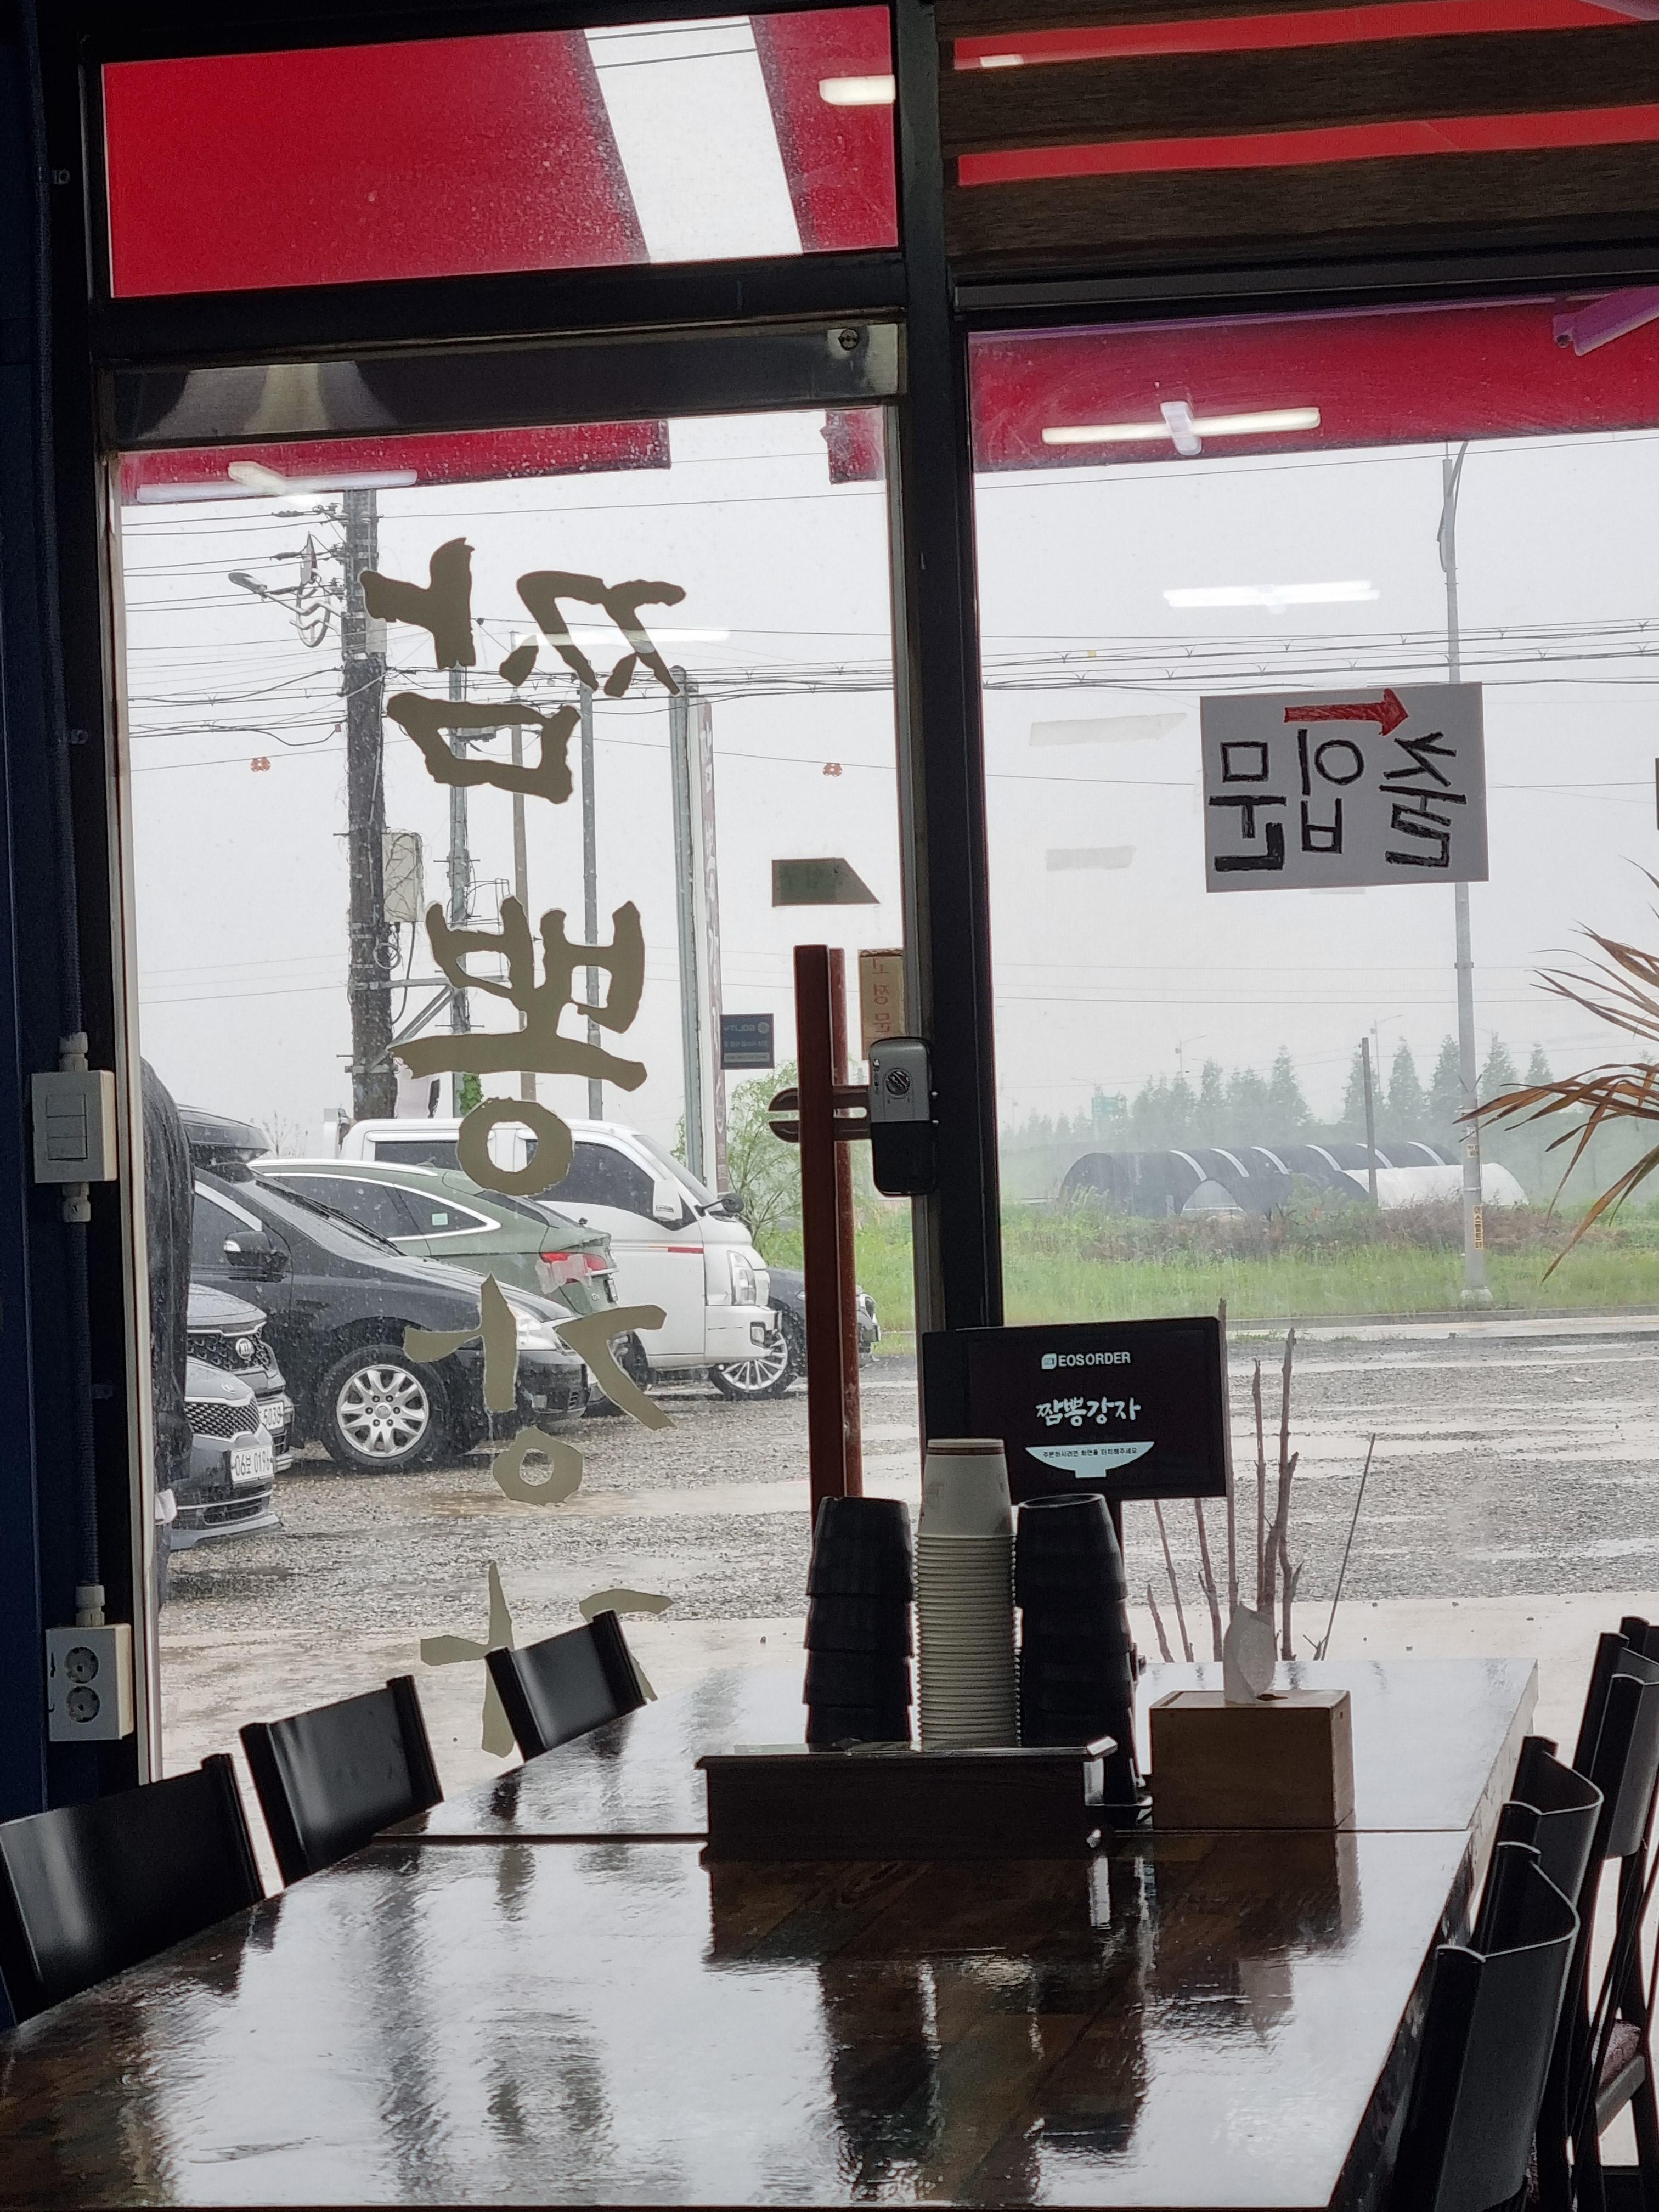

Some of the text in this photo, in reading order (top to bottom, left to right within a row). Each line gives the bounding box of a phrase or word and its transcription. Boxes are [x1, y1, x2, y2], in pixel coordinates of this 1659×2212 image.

[1035, 1396, 1142, 1426] 짬뽕강자
[1043, 1449, 1079, 1458] 주문하시려면
[1101, 1447, 1137, 1455] 터치해주세요
